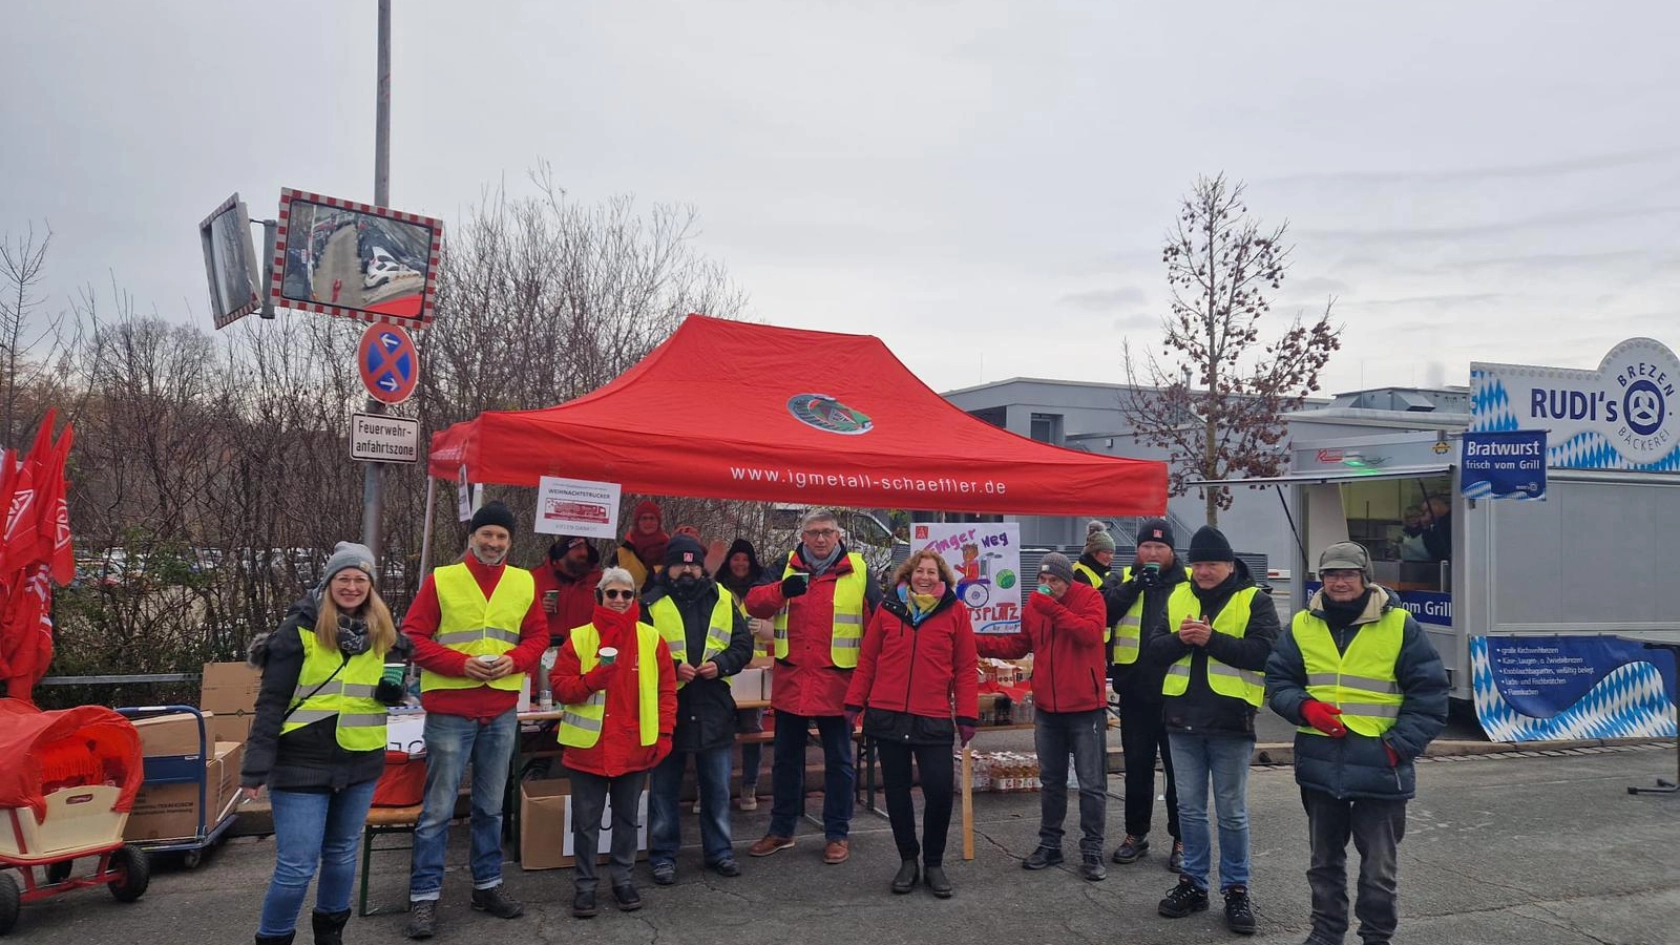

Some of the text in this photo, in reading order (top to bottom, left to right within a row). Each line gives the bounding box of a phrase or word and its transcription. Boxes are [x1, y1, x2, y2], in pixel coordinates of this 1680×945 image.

[1617, 363, 1675, 397] BREZEN
[1531, 388, 1618, 422] RUDI's
[358, 420, 412, 437] Feuerwehr-
[356, 440, 414, 456] anfahrtszone
[1467, 441, 1540, 456] Bratwurst
[1466, 460, 1491, 469] frisch
[1519, 460, 1540, 469] Grill
[730, 466, 1006, 494] www.igmetall-schaeffler.de
[548, 488, 611, 499] WEIHNACHTSTRUCKER
[1425, 601, 1451, 616] Grill
